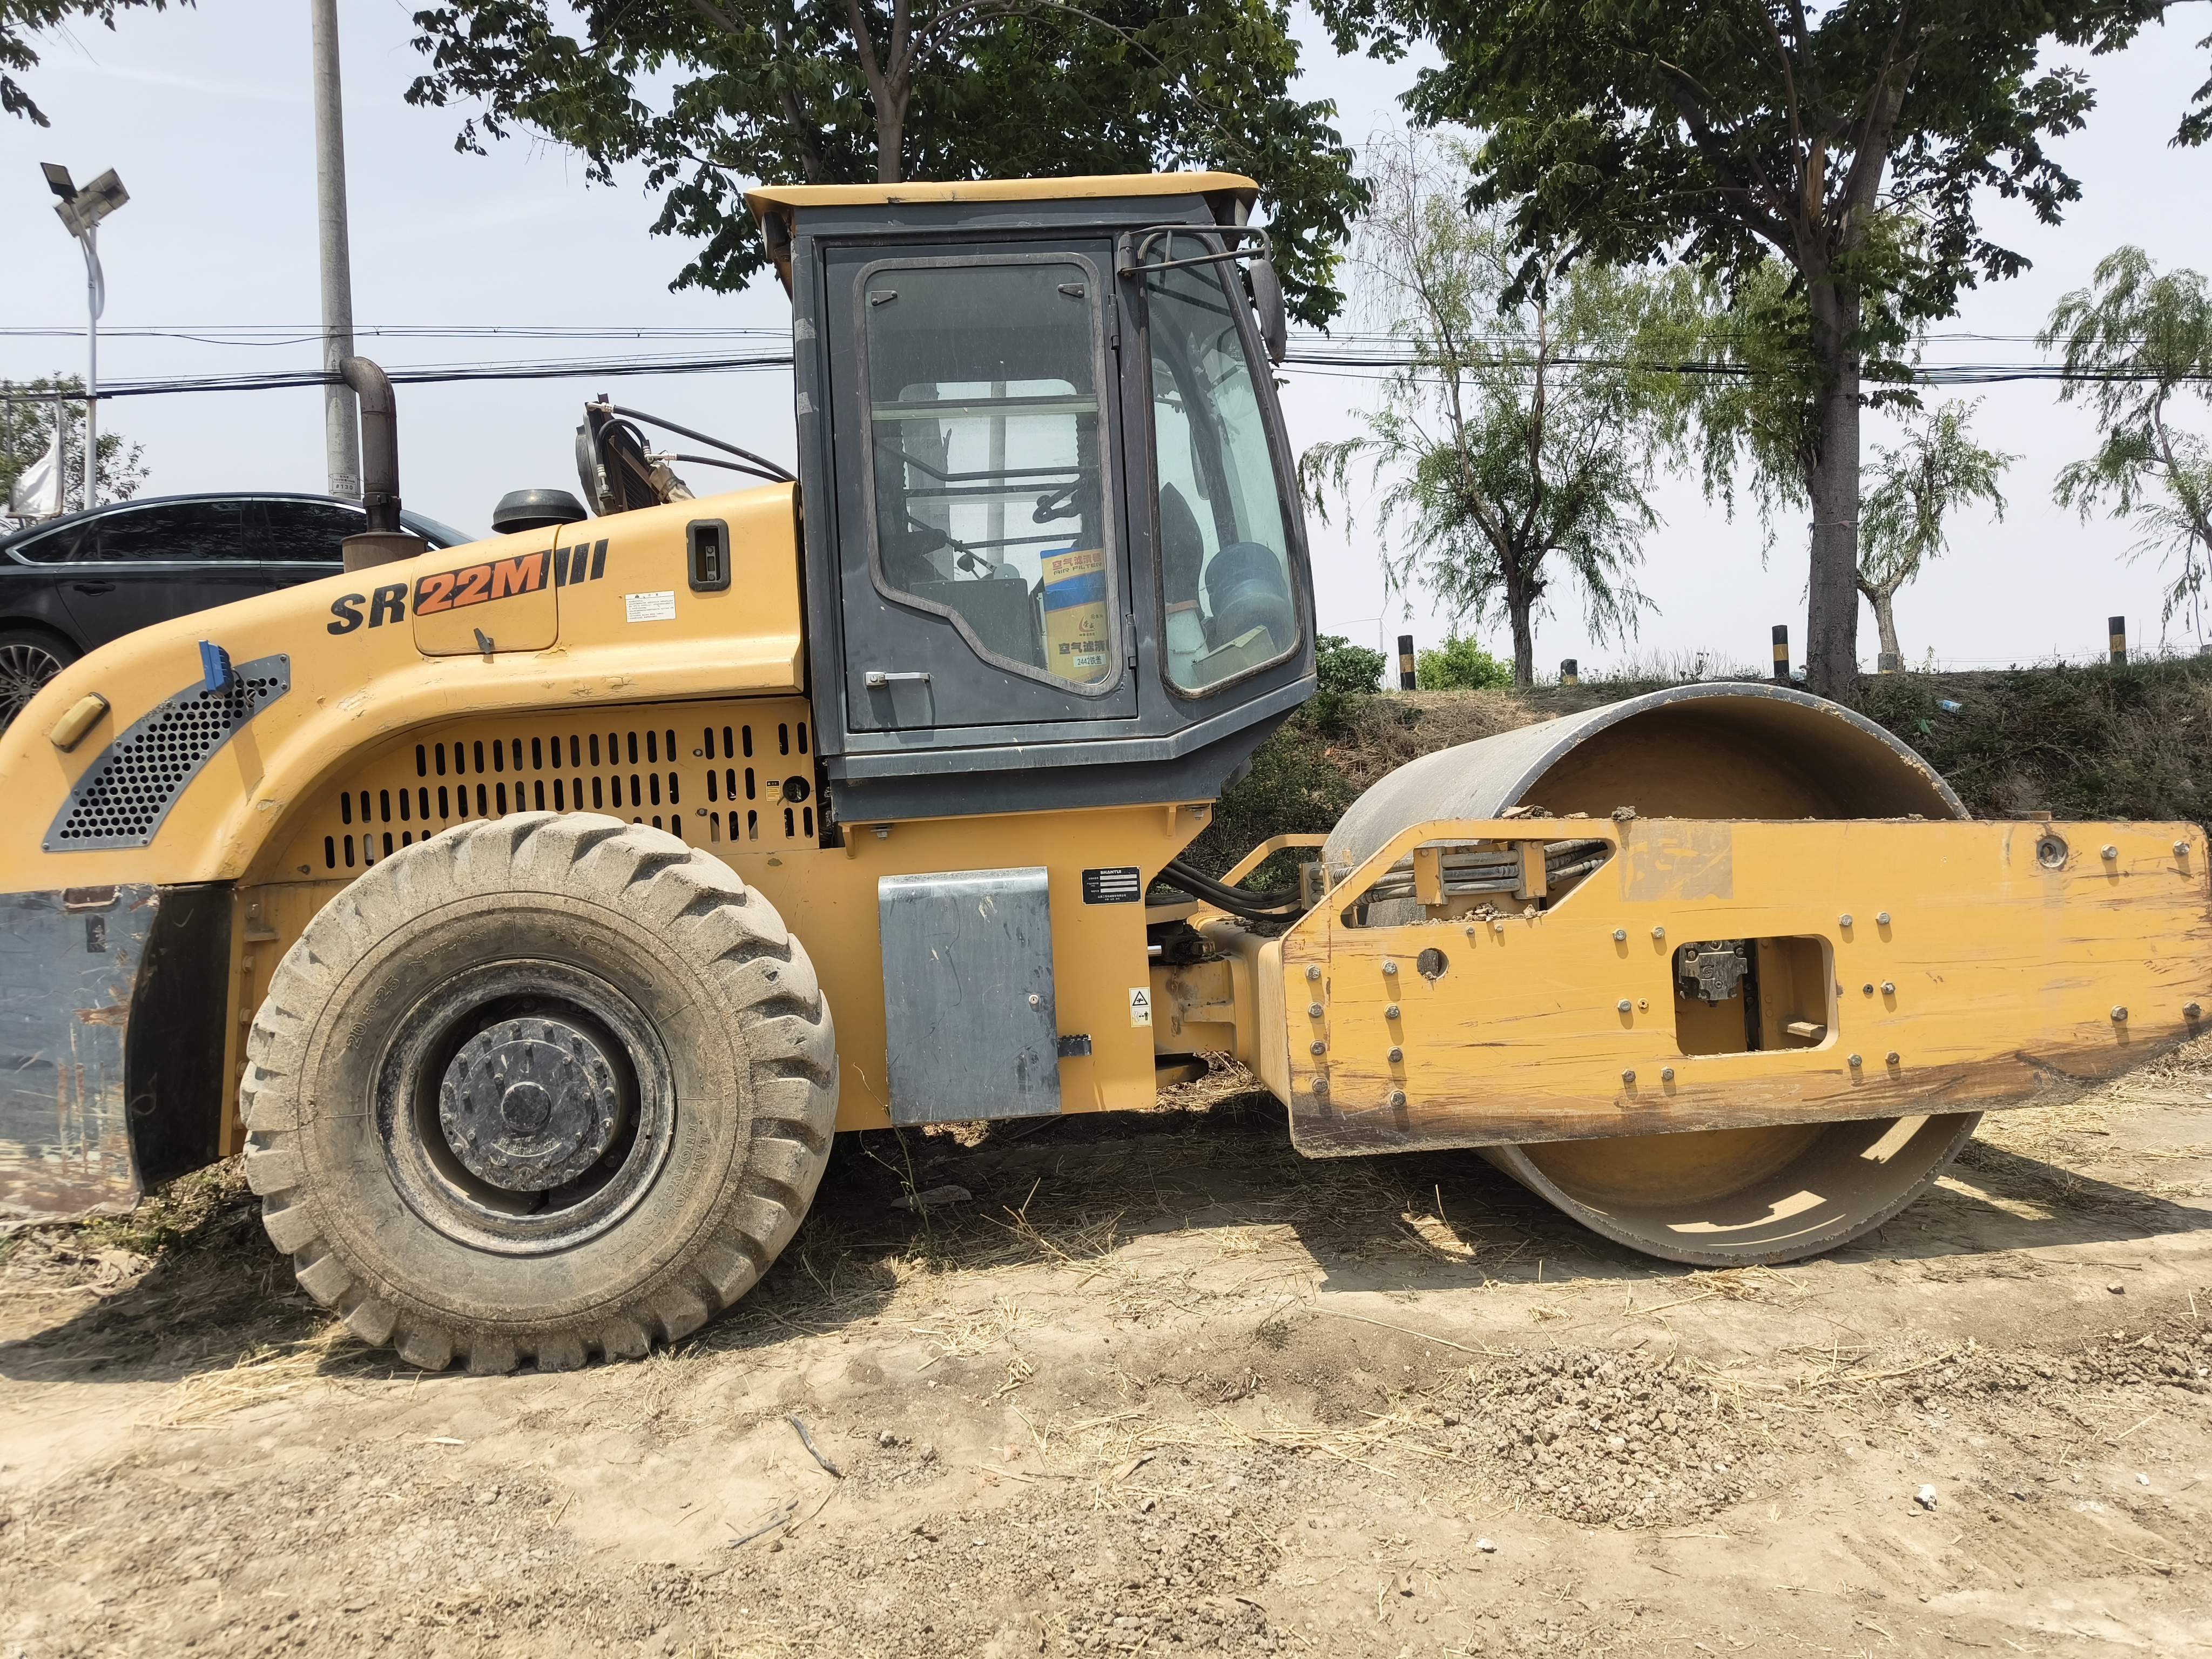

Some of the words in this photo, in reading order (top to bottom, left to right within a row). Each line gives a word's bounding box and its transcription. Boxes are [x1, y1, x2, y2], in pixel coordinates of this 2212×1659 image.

[1054, 568, 1070, 576] AIR
[1073, 562, 1102, 571] FILTER
[346, 974, 400, 1049] 20.5-25
[408, 930, 488, 972] NYLON
